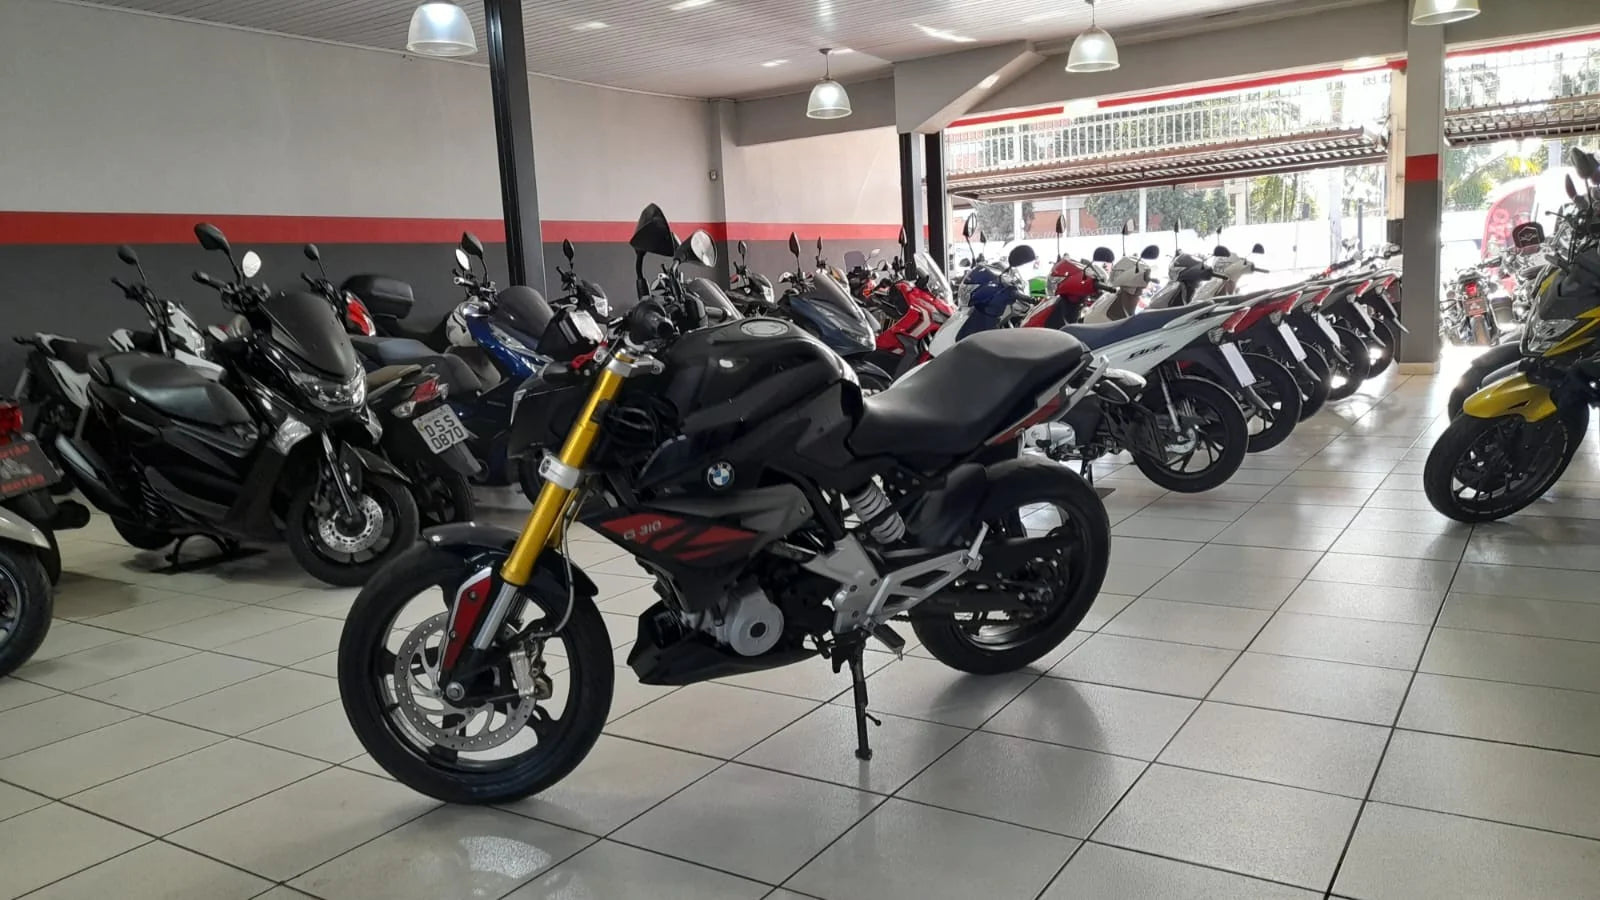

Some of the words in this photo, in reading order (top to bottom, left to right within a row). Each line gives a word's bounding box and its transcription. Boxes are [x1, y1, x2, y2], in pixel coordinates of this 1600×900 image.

[424, 415, 456, 437] DSS
[431, 426, 464, 450] 0870
[639, 519, 662, 536] 310
